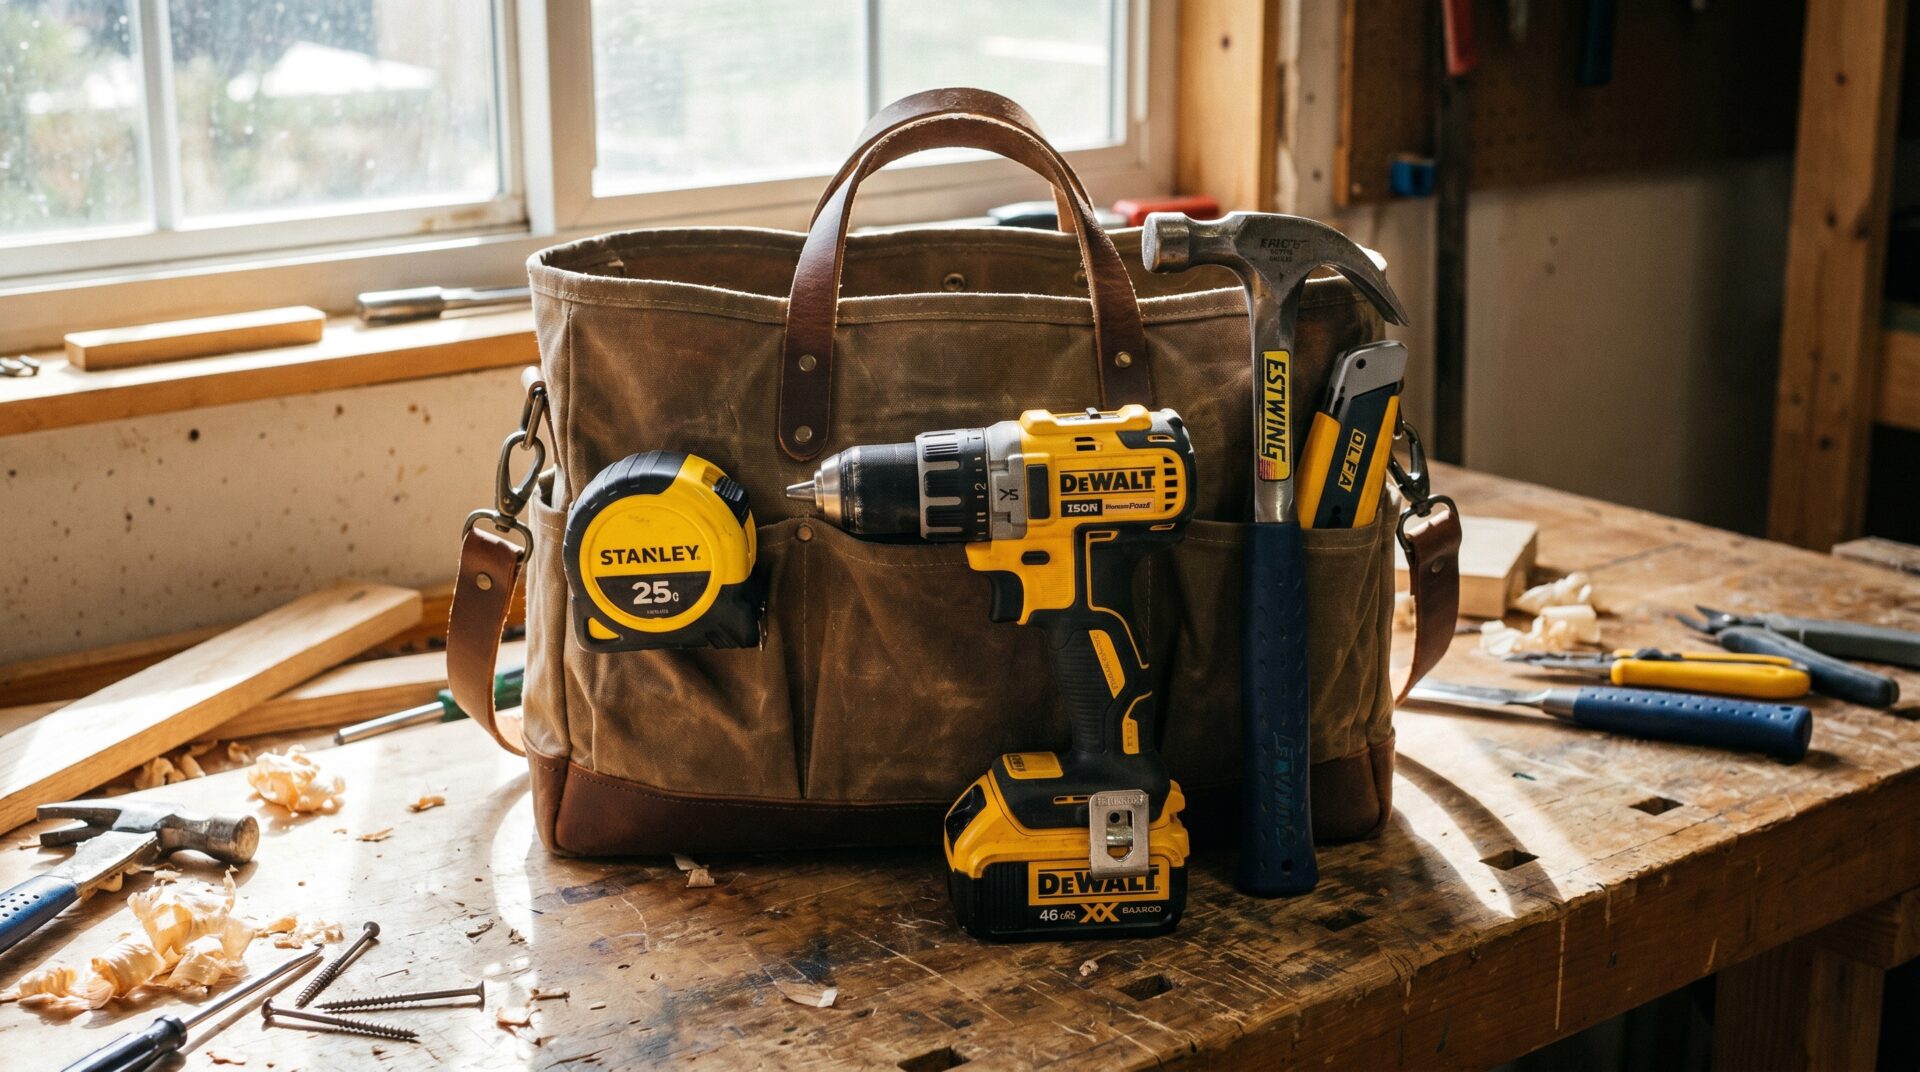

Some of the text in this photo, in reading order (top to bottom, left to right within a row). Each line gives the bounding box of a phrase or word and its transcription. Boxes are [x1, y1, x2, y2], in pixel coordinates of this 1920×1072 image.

[1264, 358, 1286, 462] ESTWING
[1339, 431, 1365, 487] OLFA
[600, 545, 699, 566] STANLEY
[1039, 909, 1059, 921] 46
